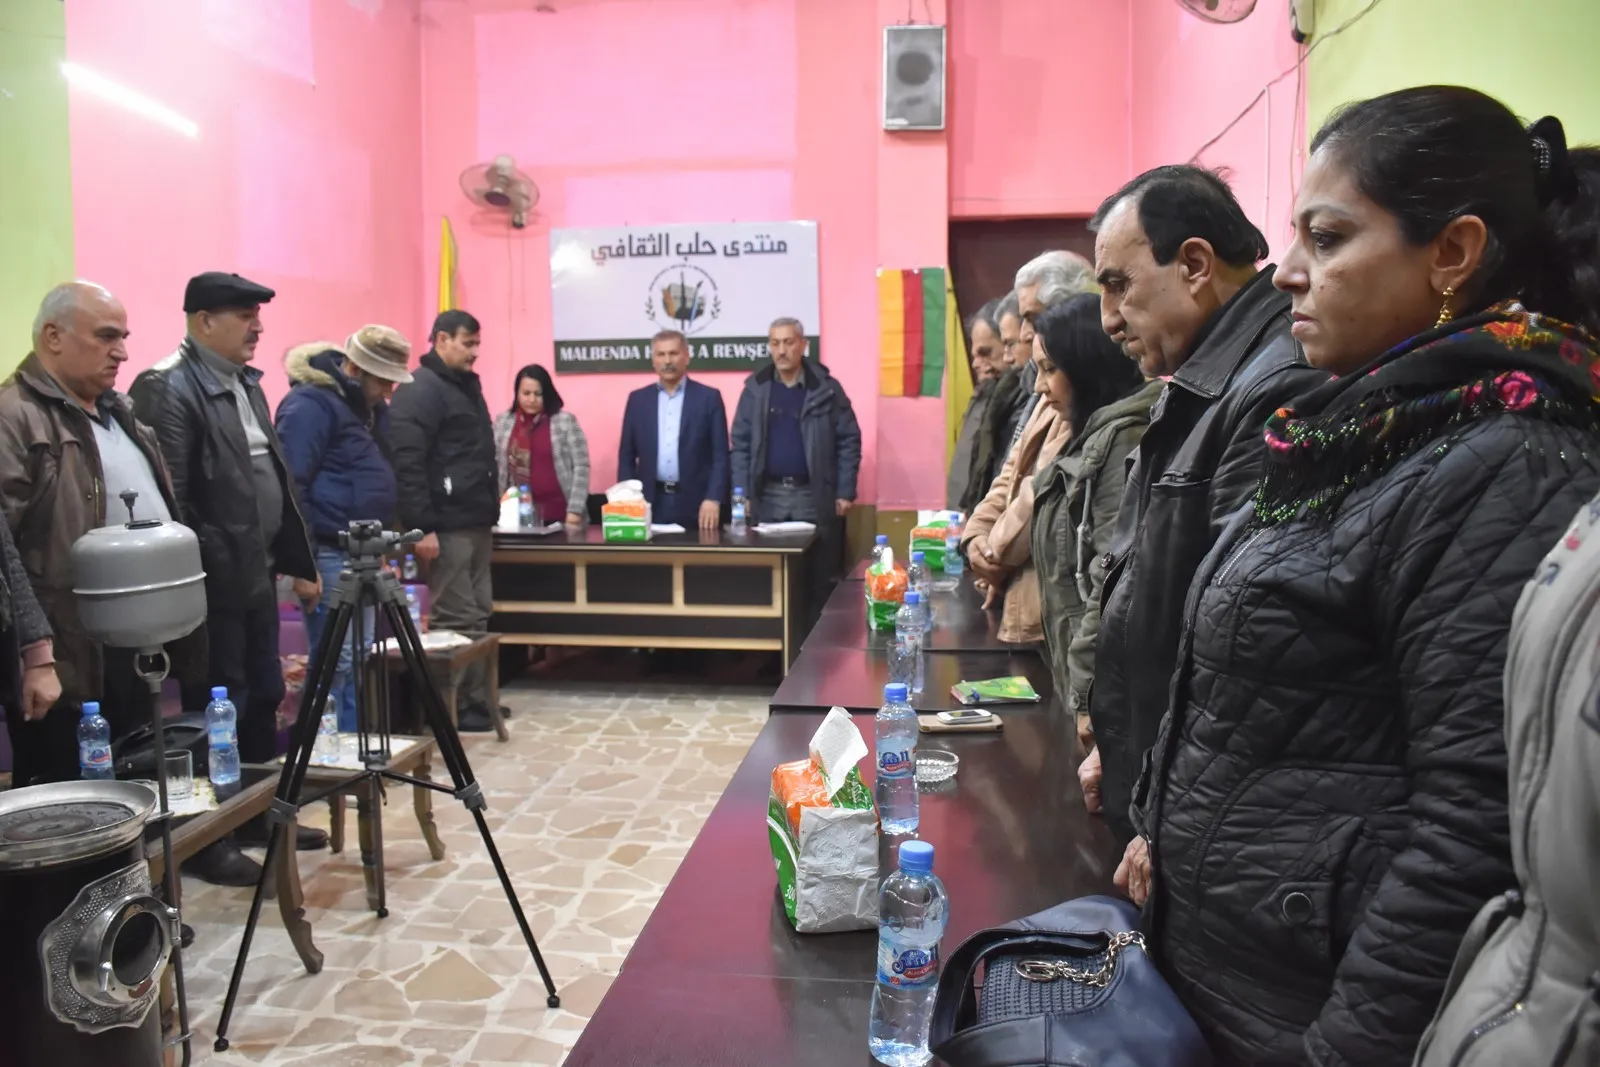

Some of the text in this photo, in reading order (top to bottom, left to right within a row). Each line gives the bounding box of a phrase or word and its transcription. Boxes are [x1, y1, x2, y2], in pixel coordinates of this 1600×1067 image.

[591, 232, 788, 266] منتدى حلب الثقافي
[560, 345, 641, 361] MALBENDA
[698, 344, 710, 359] A
